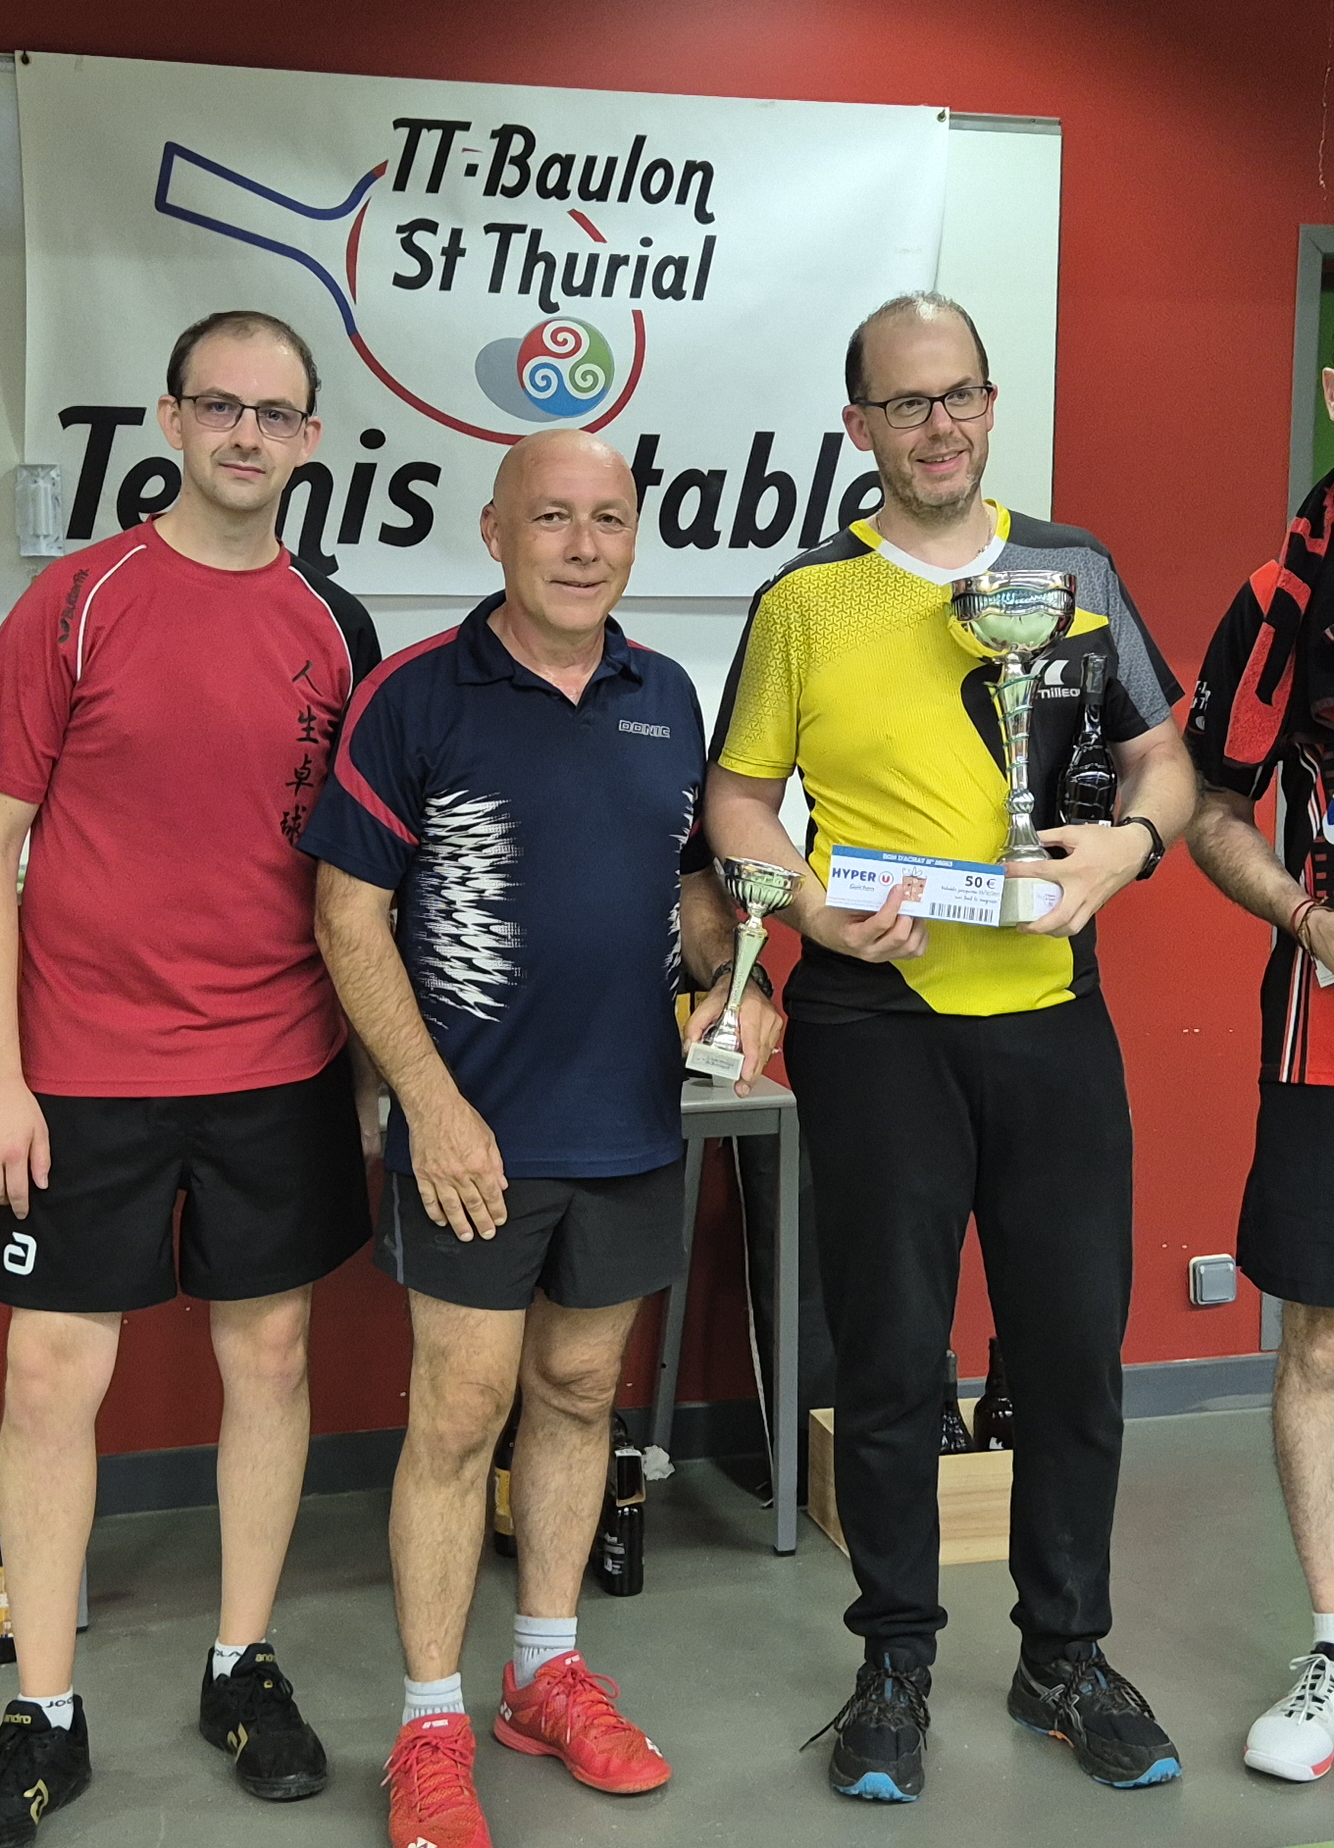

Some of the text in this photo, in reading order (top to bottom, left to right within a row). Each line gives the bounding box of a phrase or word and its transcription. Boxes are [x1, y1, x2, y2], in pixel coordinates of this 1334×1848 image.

[392, 218, 717, 314] St Thurial
[58, 405, 441, 577] Tenis
[618, 719, 671, 739] DONIC
[832, 867, 877, 883] HYPER
[964, 875, 997, 889] 50 €
